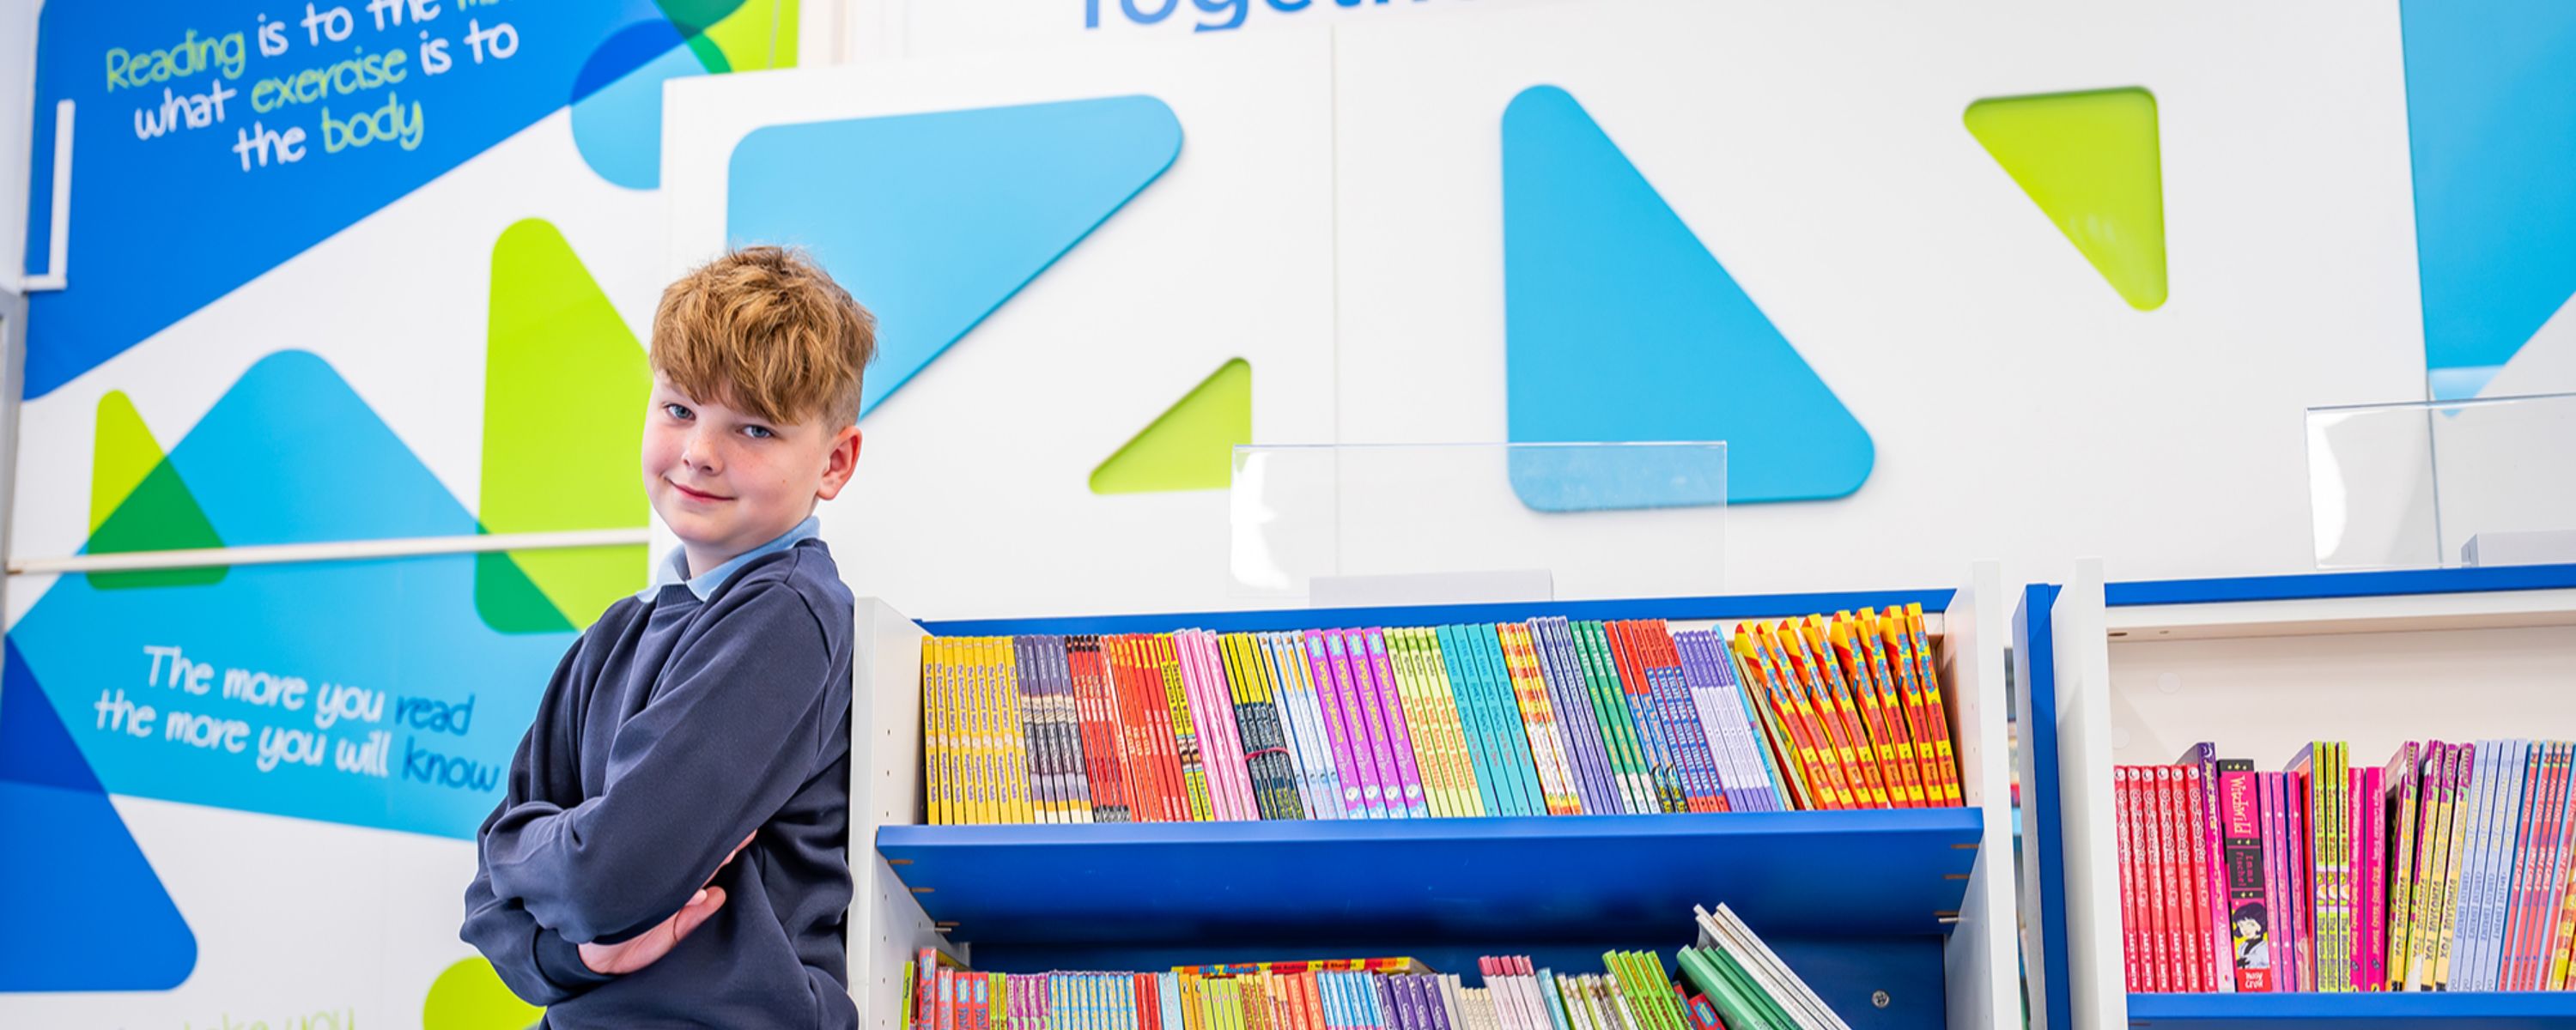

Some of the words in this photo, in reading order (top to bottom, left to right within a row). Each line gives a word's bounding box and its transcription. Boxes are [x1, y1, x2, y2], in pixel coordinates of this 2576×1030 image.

[106, 28, 246, 93] Reading
[258, 14, 289, 58] is
[301, 2, 354, 46] to
[135, 79, 236, 140] what
[252, 45, 407, 112] exercise
[420, 30, 452, 76] is
[464, 19, 519, 64] to
[233, 121, 307, 173] the
[319, 90, 424, 154] body
[143, 644, 215, 695] The
[223, 669, 309, 710] more
[315, 682, 385, 730] you
[395, 693, 475, 736] read
[1163, 665, 1176, 703] Jacqueline
[1173, 706, 1182, 729] Wilson
[1172, 663, 1186, 703] Jacqueline
[1182, 705, 1191, 729] Wilson
[1315, 660, 1330, 691] Penguin
[1334, 659, 1350, 689] Penguin
[94, 688, 157, 737] the
[165, 712, 250, 754] more
[257, 728, 326, 772] you
[336, 730, 392, 778] will
[401, 736, 501, 792] know
[1434, 728, 1443, 749] Anna
[1662, 680, 1670, 698] ESCAPE
[1668, 704, 1678, 720] FROM
[1675, 724, 1684, 743] SILVER
[1682, 748, 1692, 767] STREET
[1692, 772, 1701, 790] FARM
[1670, 678, 1680, 698] ESCAPE
[1677, 704, 1686, 719] FROM
[1683, 723, 1693, 742] SILVER
[1691, 747, 1700, 767] STREET
[1700, 772, 1710, 790] FARM
[1680, 678, 1690, 698] ESCAPE
[1686, 704, 1696, 719] FROM
[1691, 723, 1701, 742] SILVER
[1699, 747, 1709, 767] STREET
[1709, 772, 1718, 791] FARM
[2524, 803, 2532, 822] FINE
[2245, 855, 2254, 883] Emma
[2328, 918, 2337, 930] The
[2341, 918, 2349, 930] The
[2397, 877, 2408, 929] DINOSAUR
[2428, 882, 2442, 932] DINOSAUR
[2444, 878, 2458, 930] DINOSAUR
[1198, 965, 1219, 975] Billy
